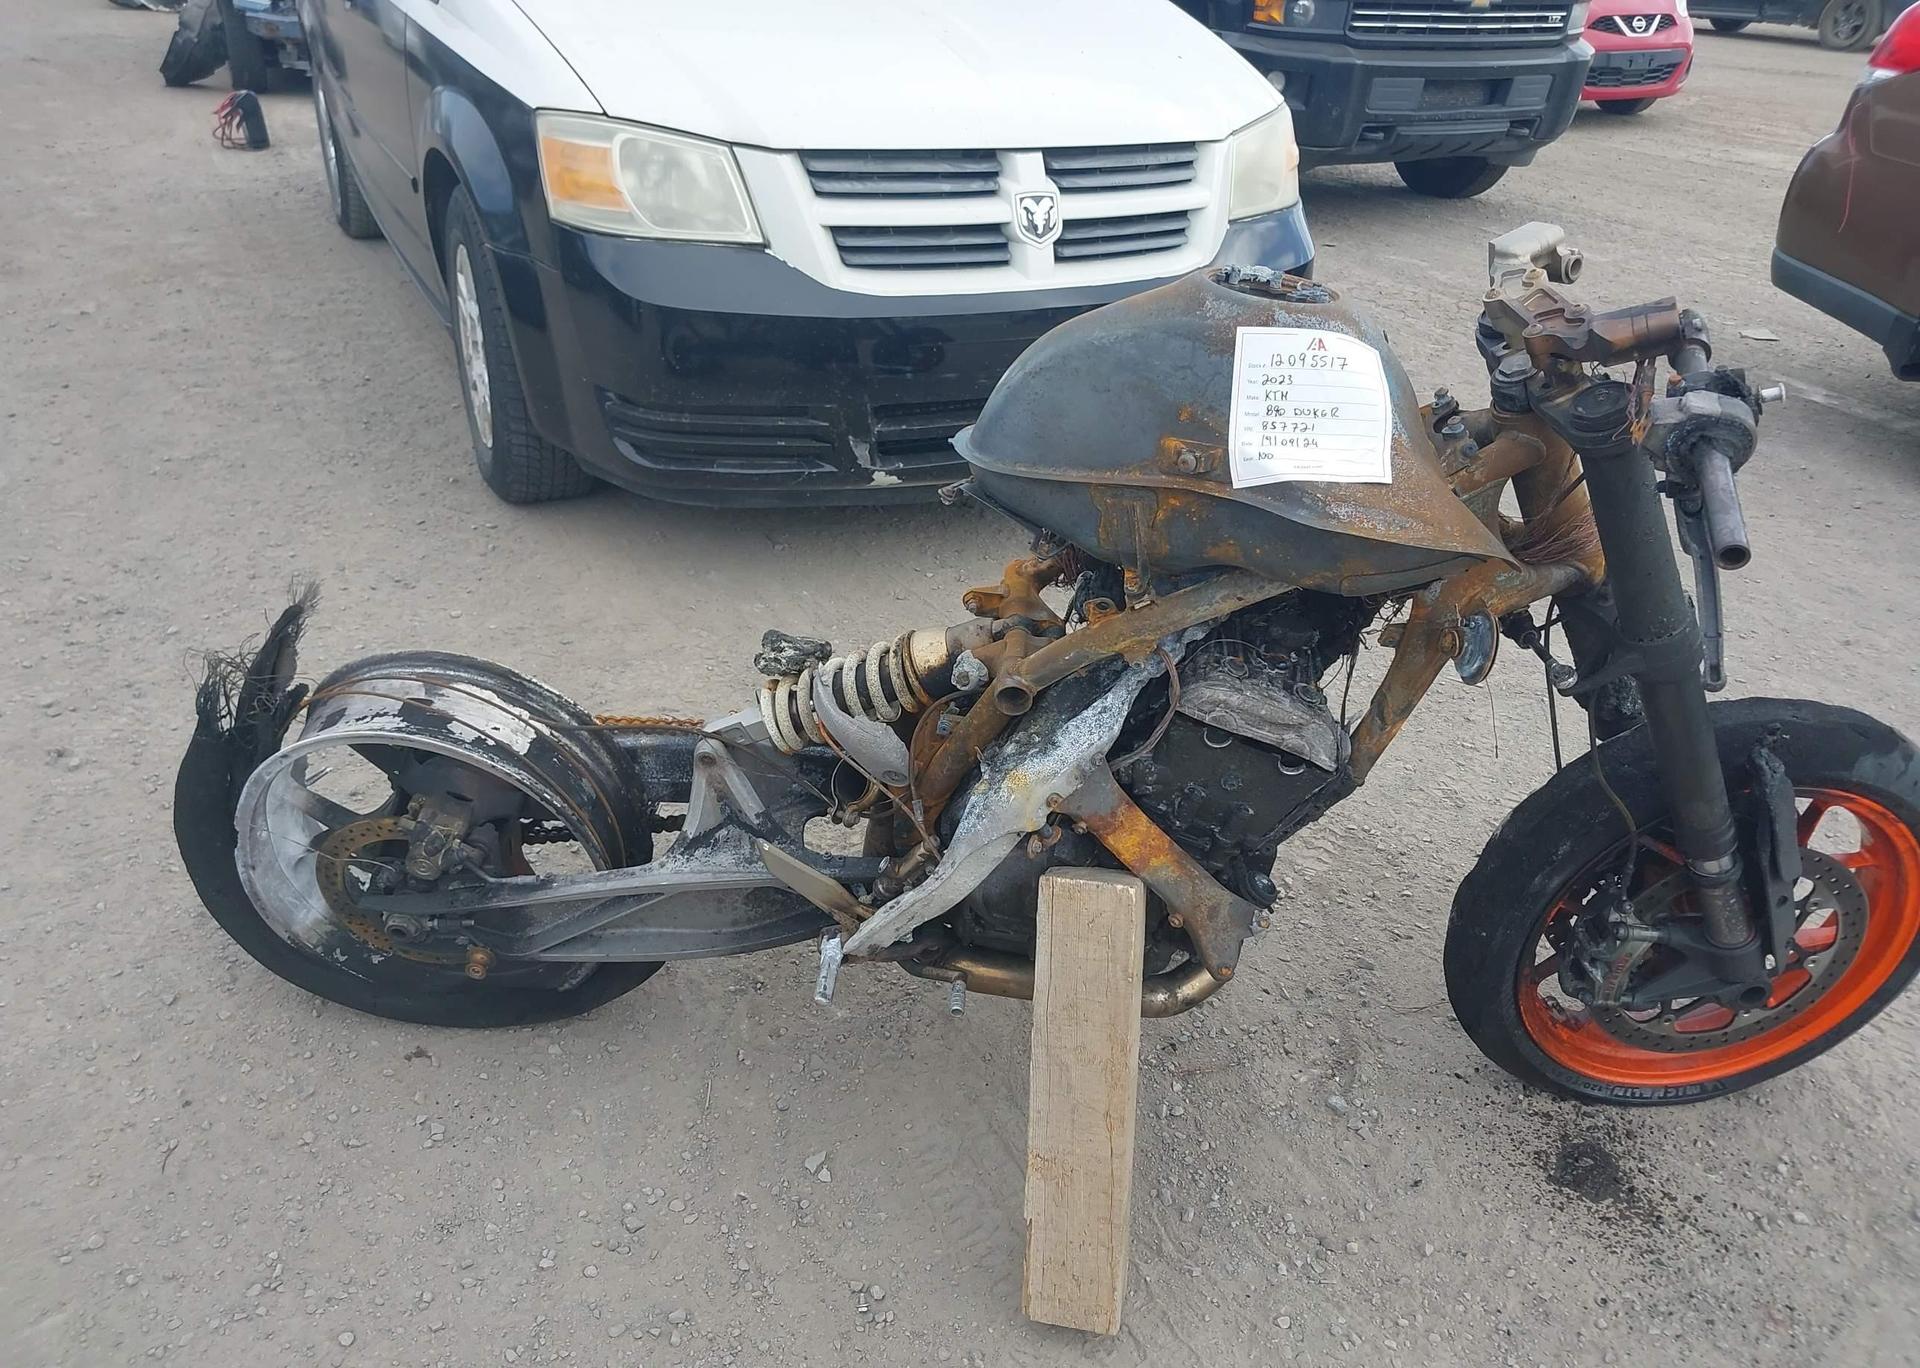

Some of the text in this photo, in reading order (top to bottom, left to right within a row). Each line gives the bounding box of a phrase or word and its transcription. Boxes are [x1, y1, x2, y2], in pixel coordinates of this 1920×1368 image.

[1548, 15, 1562, 24] LTZ
[1270, 353, 1349, 371] 12095517
[1261, 373, 1293, 386] 2023
[1264, 389, 1289, 402] KTM
[1261, 420, 1315, 433] 857721
